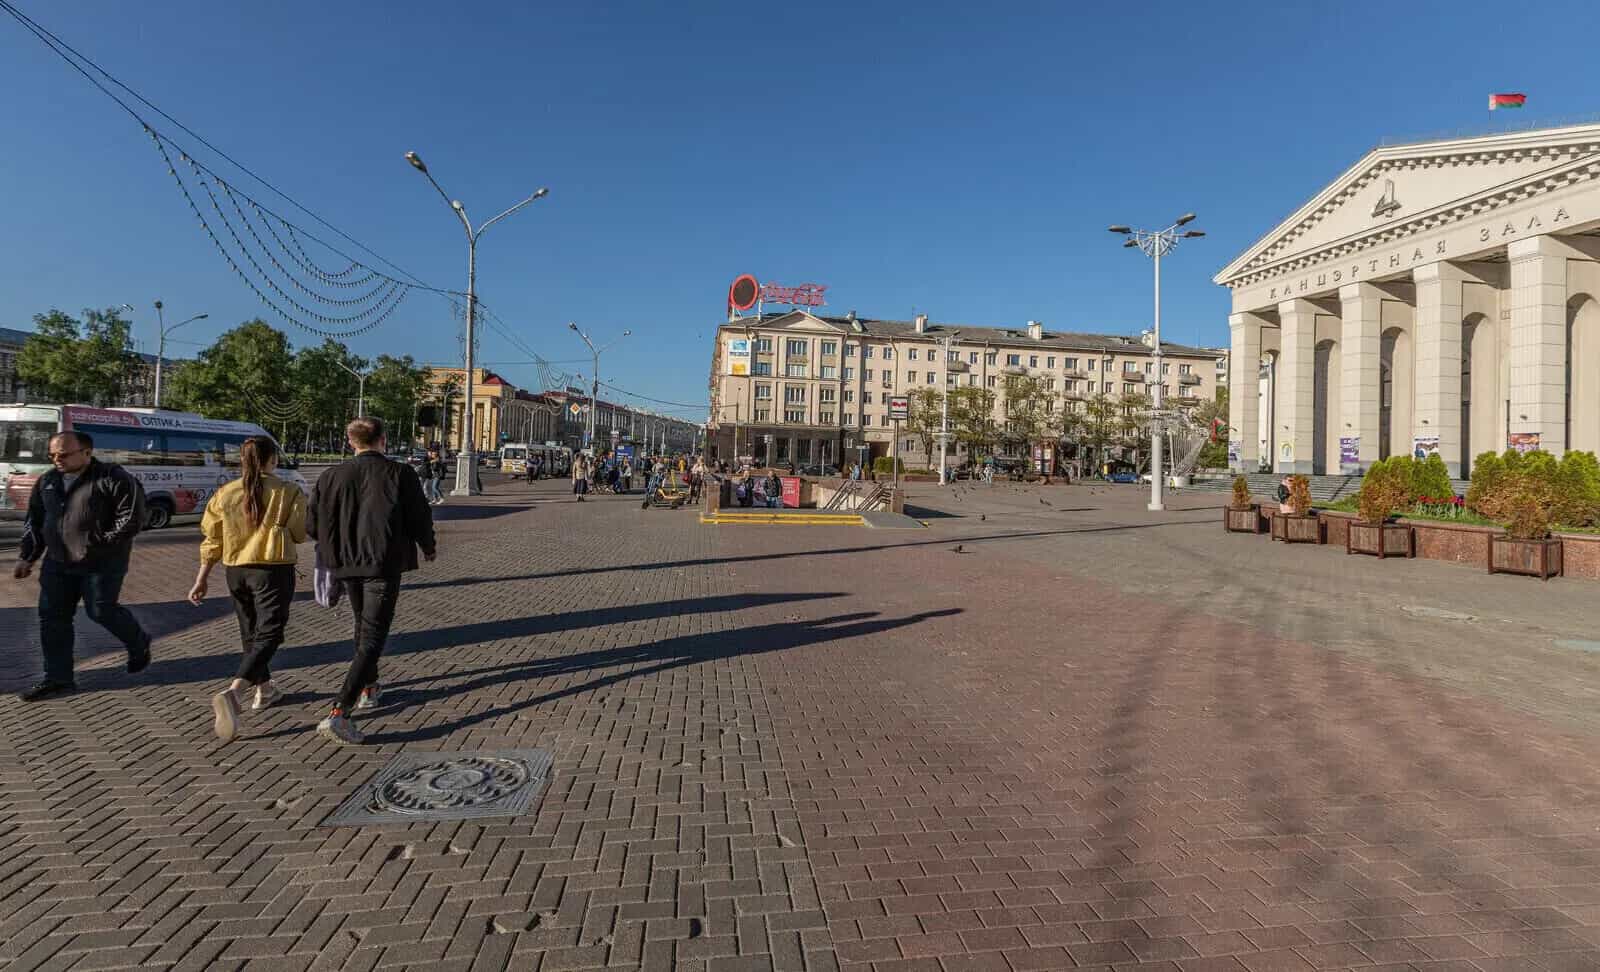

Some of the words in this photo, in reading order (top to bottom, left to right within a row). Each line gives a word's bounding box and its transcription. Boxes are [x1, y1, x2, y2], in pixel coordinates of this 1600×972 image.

[1270, 239, 1447, 300] КАНЦЭРТНАЯ
[1480, 208, 1570, 242] ЗАЛА
[141, 416, 183, 429] ОПТИКА
